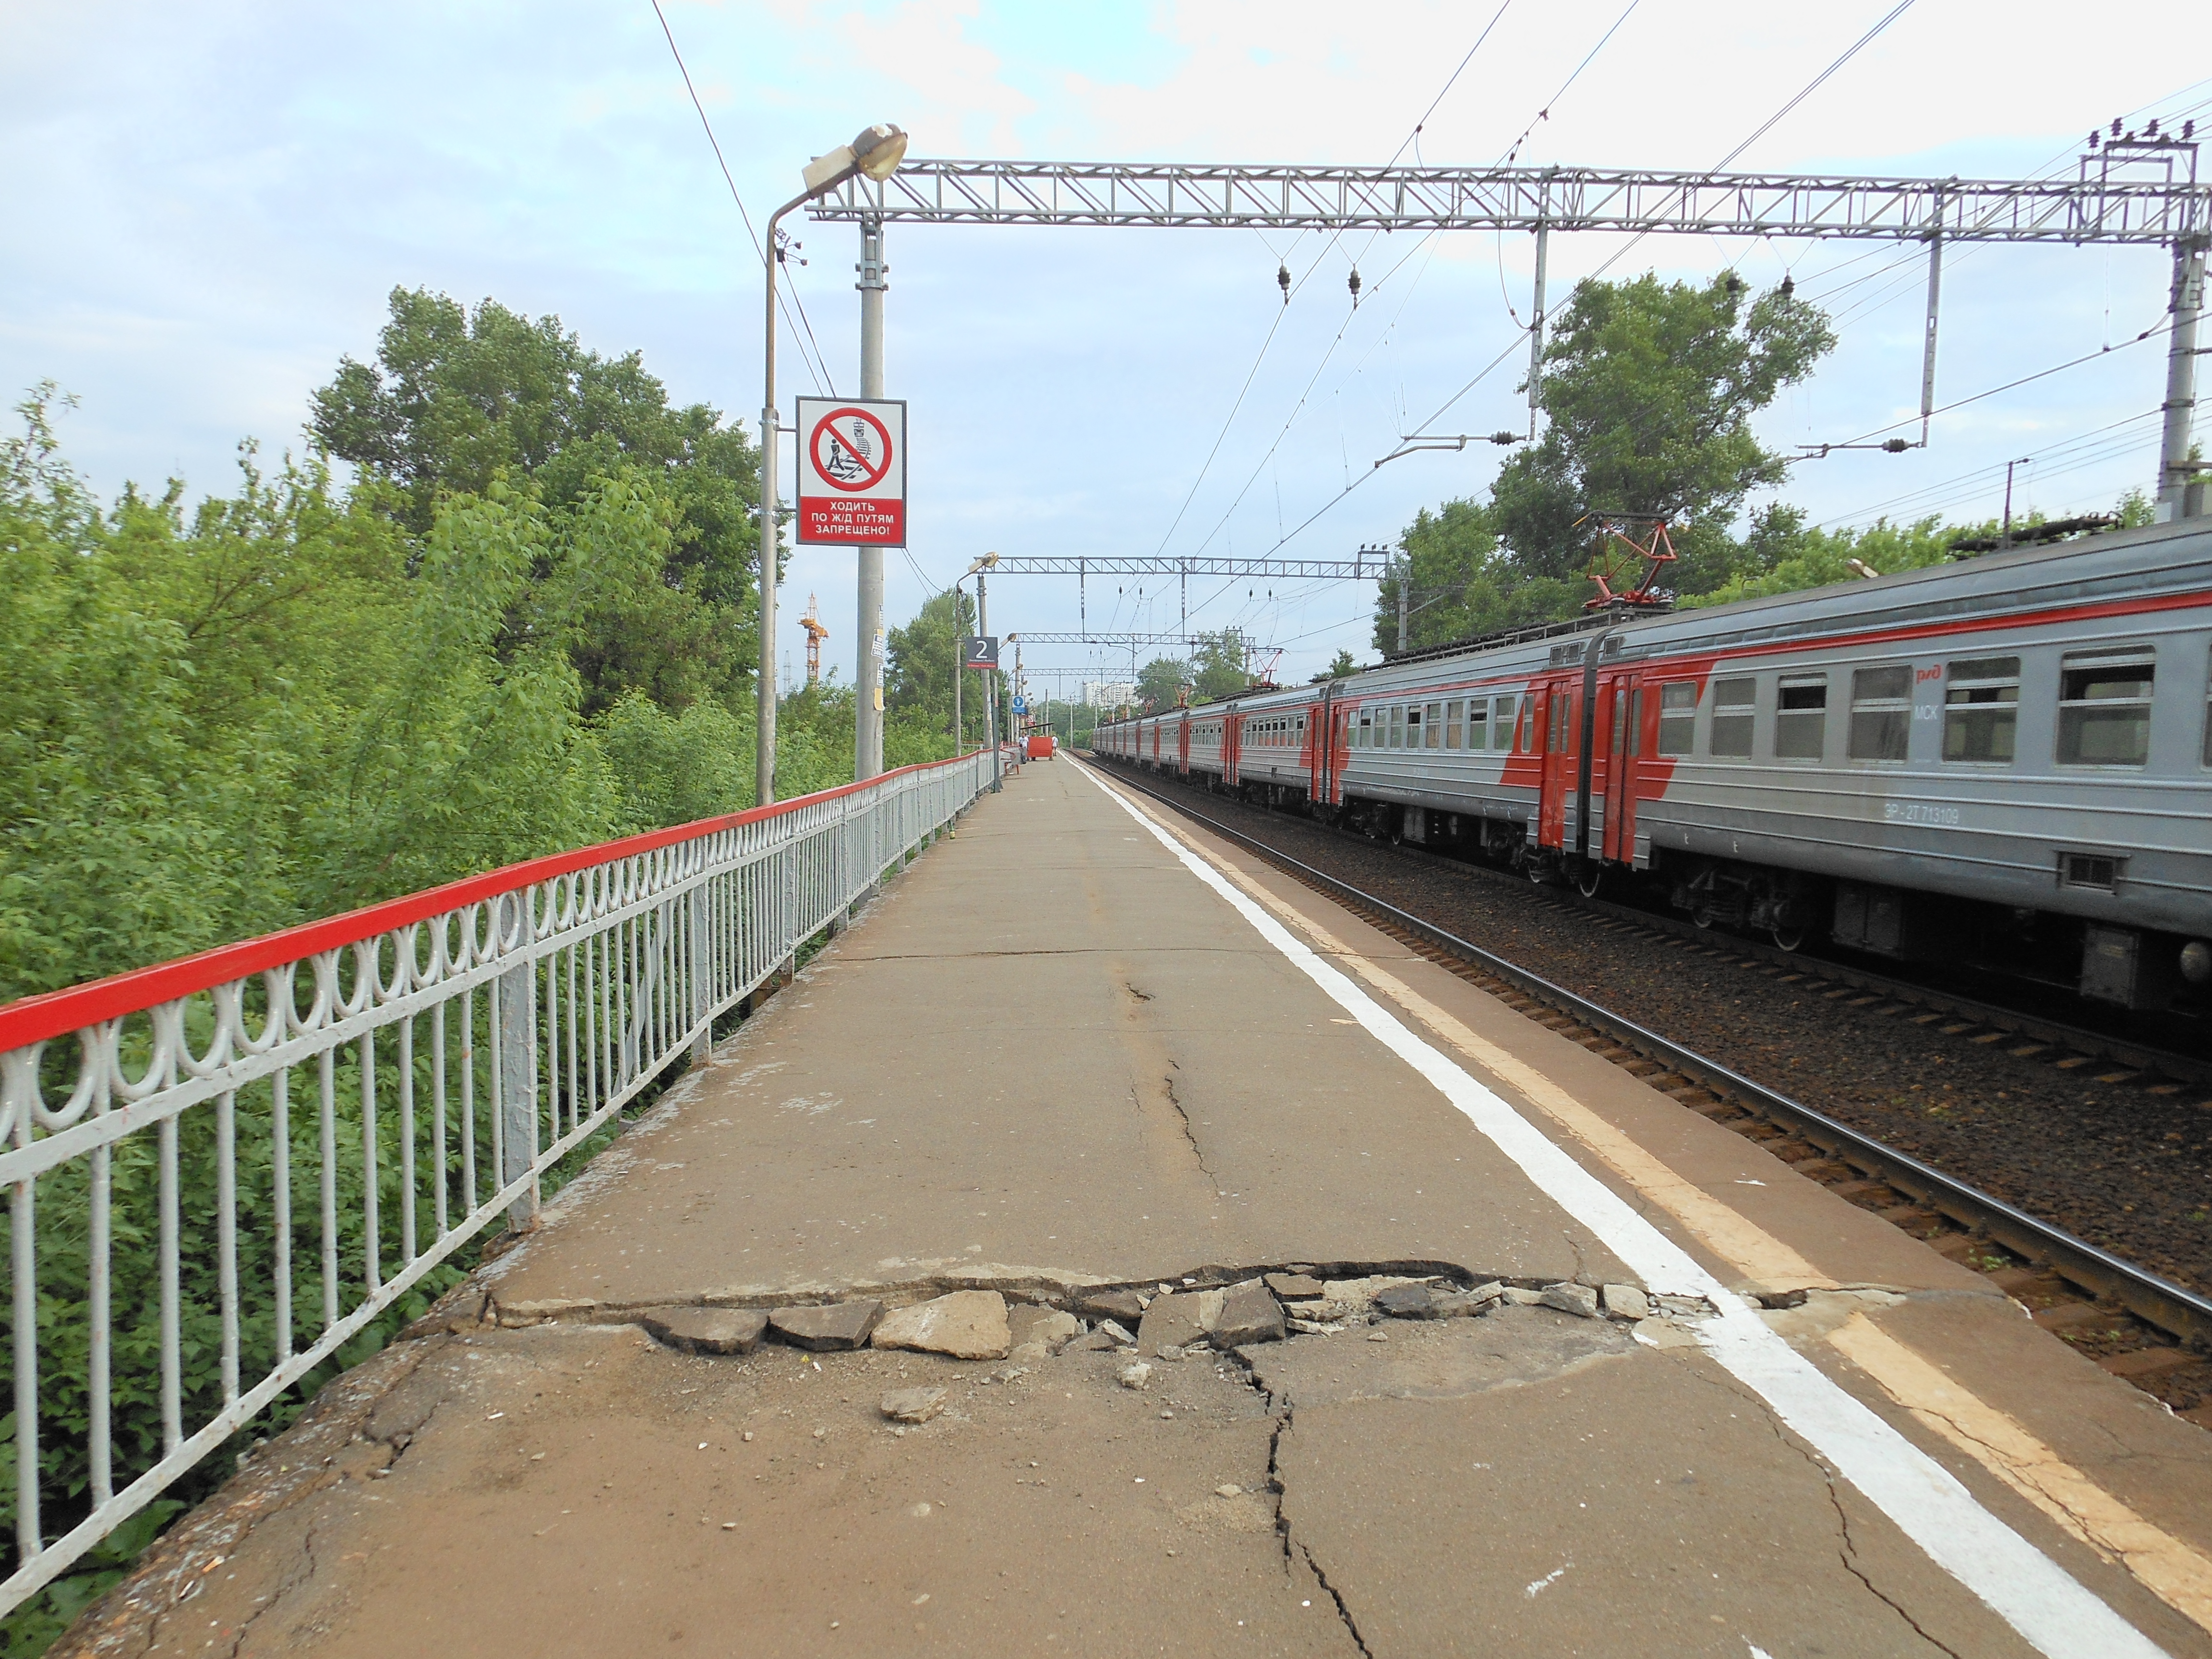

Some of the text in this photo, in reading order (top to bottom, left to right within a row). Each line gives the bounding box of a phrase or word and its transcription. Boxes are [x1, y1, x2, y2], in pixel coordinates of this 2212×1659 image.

[830, 501, 875, 512] ХОДИТЬ
[811, 513, 893, 524] ПО Ж/Д ПУТЯМ
[816, 524, 890, 535] ЗАПРЕЩЕНО!
[976, 640, 987, 659] 2
